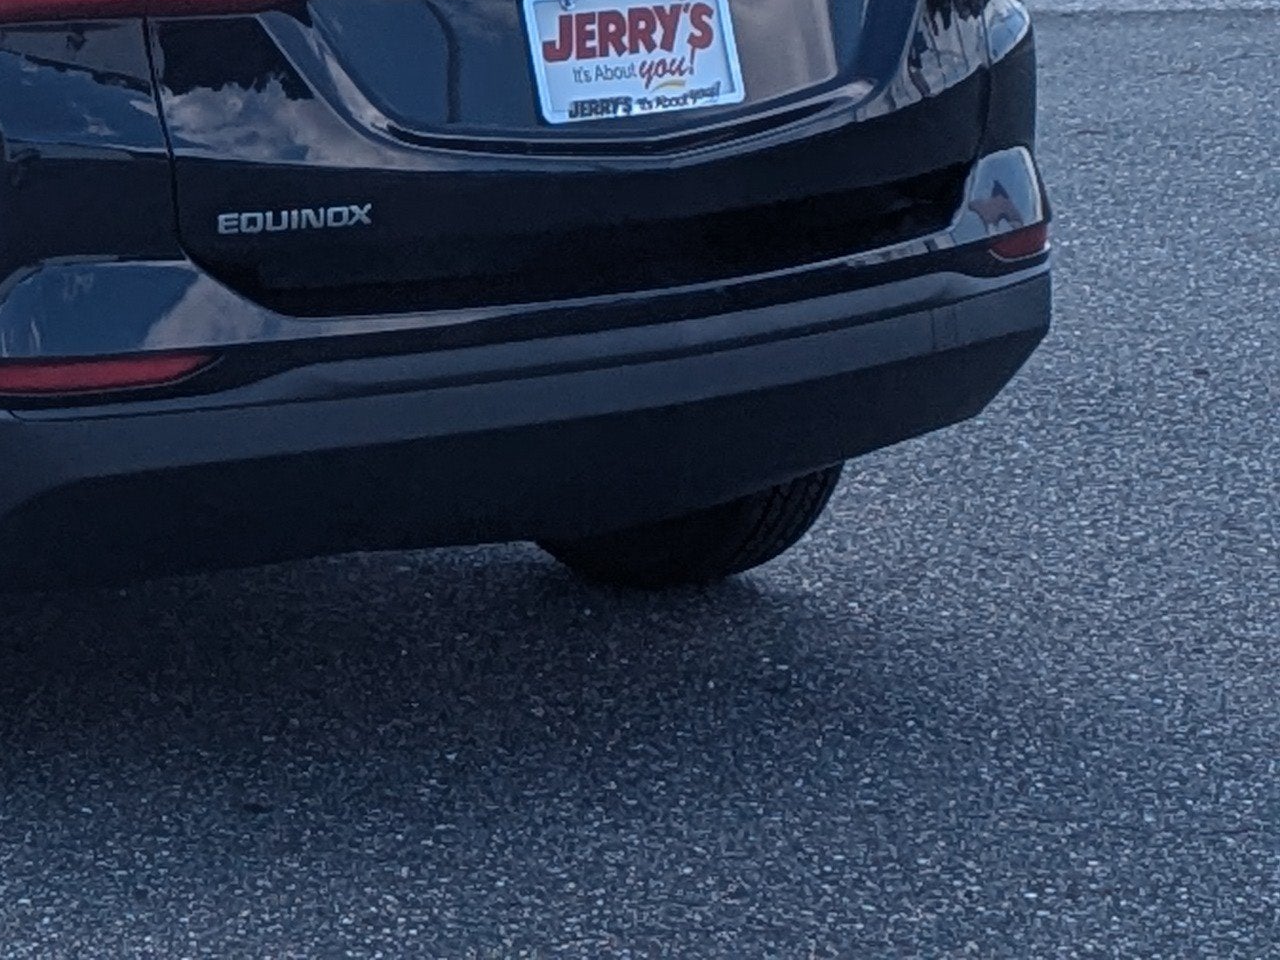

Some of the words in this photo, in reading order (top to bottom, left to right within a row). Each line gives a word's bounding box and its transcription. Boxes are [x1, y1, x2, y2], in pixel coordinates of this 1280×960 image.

[542, 2, 715, 63] JERRY'S
[572, 68, 592, 84] It's
[594, 63, 638, 82] About
[638, 47, 696, 92] you!
[217, 202, 373, 235] EQUINOX
